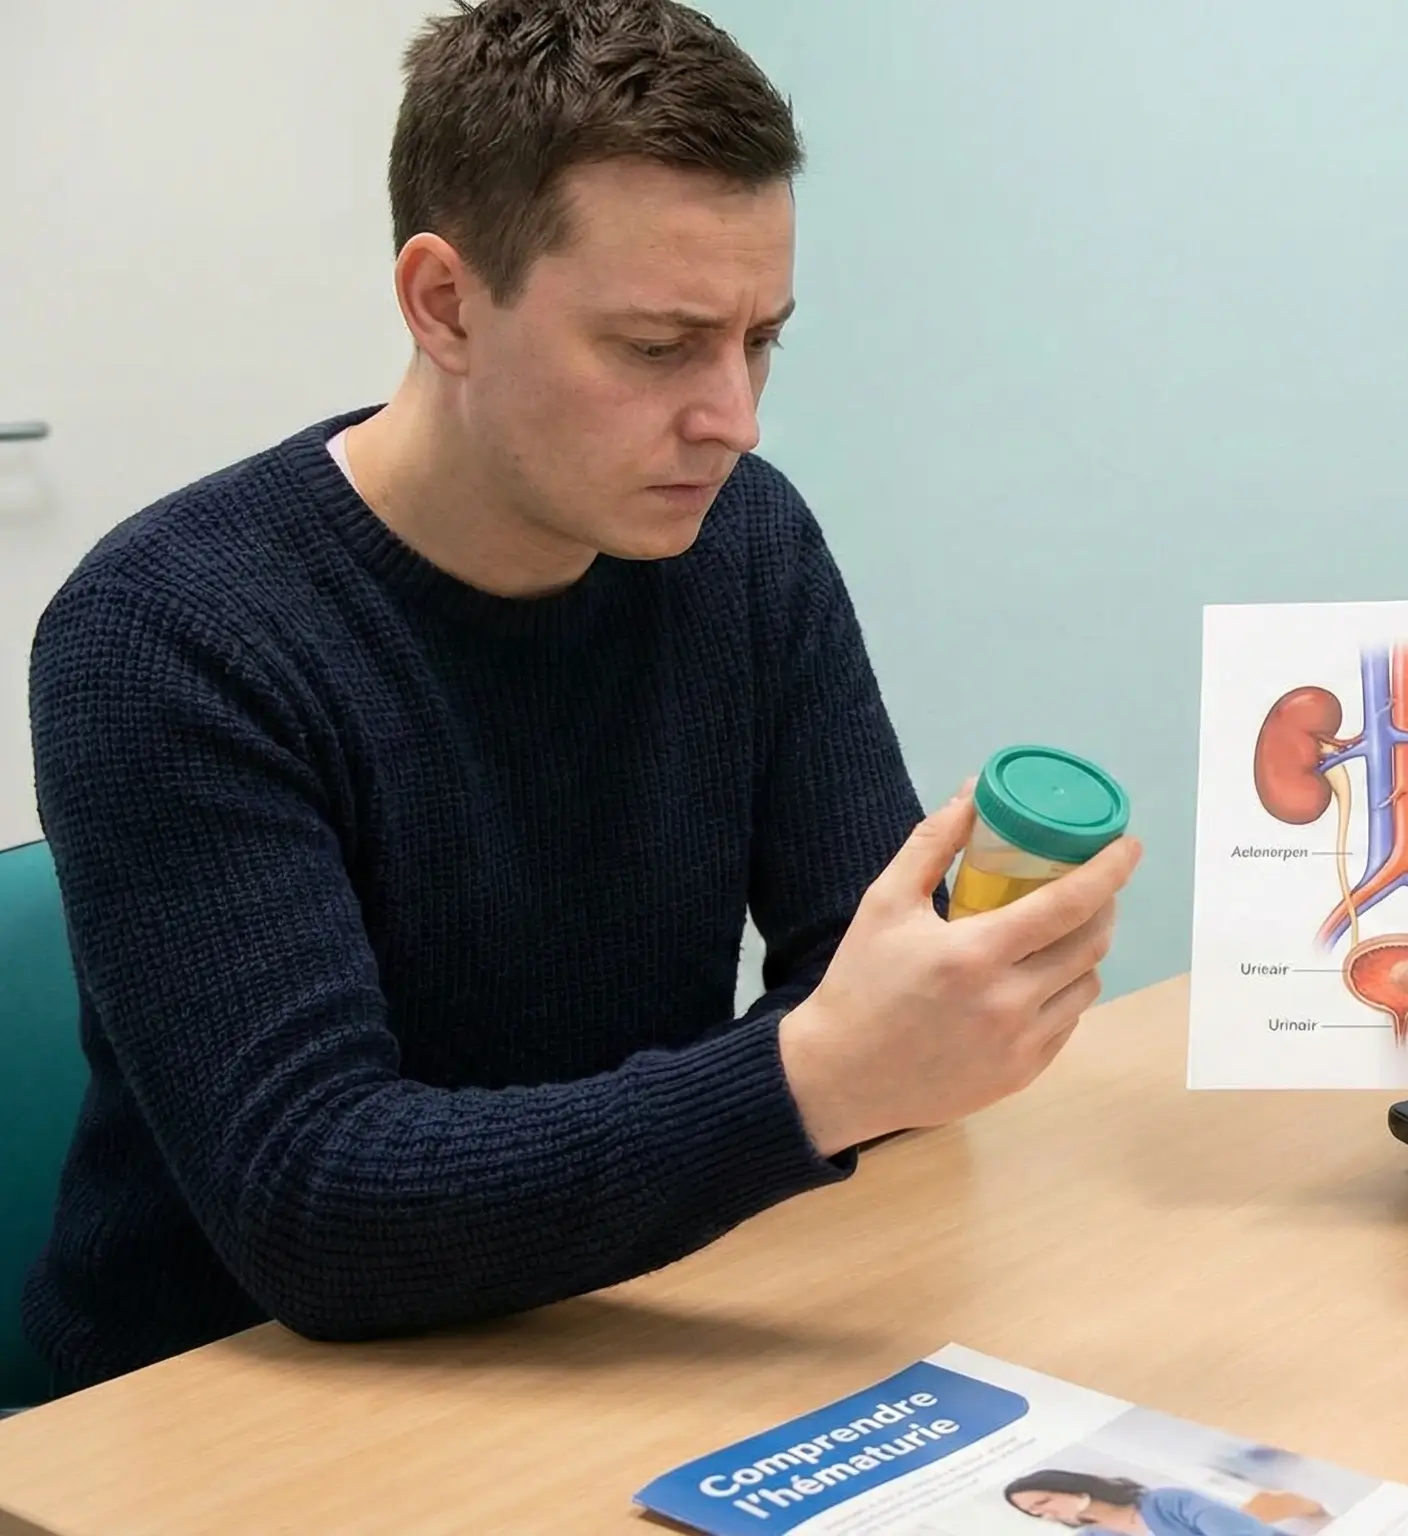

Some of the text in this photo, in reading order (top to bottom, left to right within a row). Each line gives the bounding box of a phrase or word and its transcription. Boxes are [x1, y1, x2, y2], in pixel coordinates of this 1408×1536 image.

[1269, 1018, 1319, 1031] Urinair
[699, 1391, 938, 1497] Comprendre
[733, 1418, 960, 1520] l'hématurie
